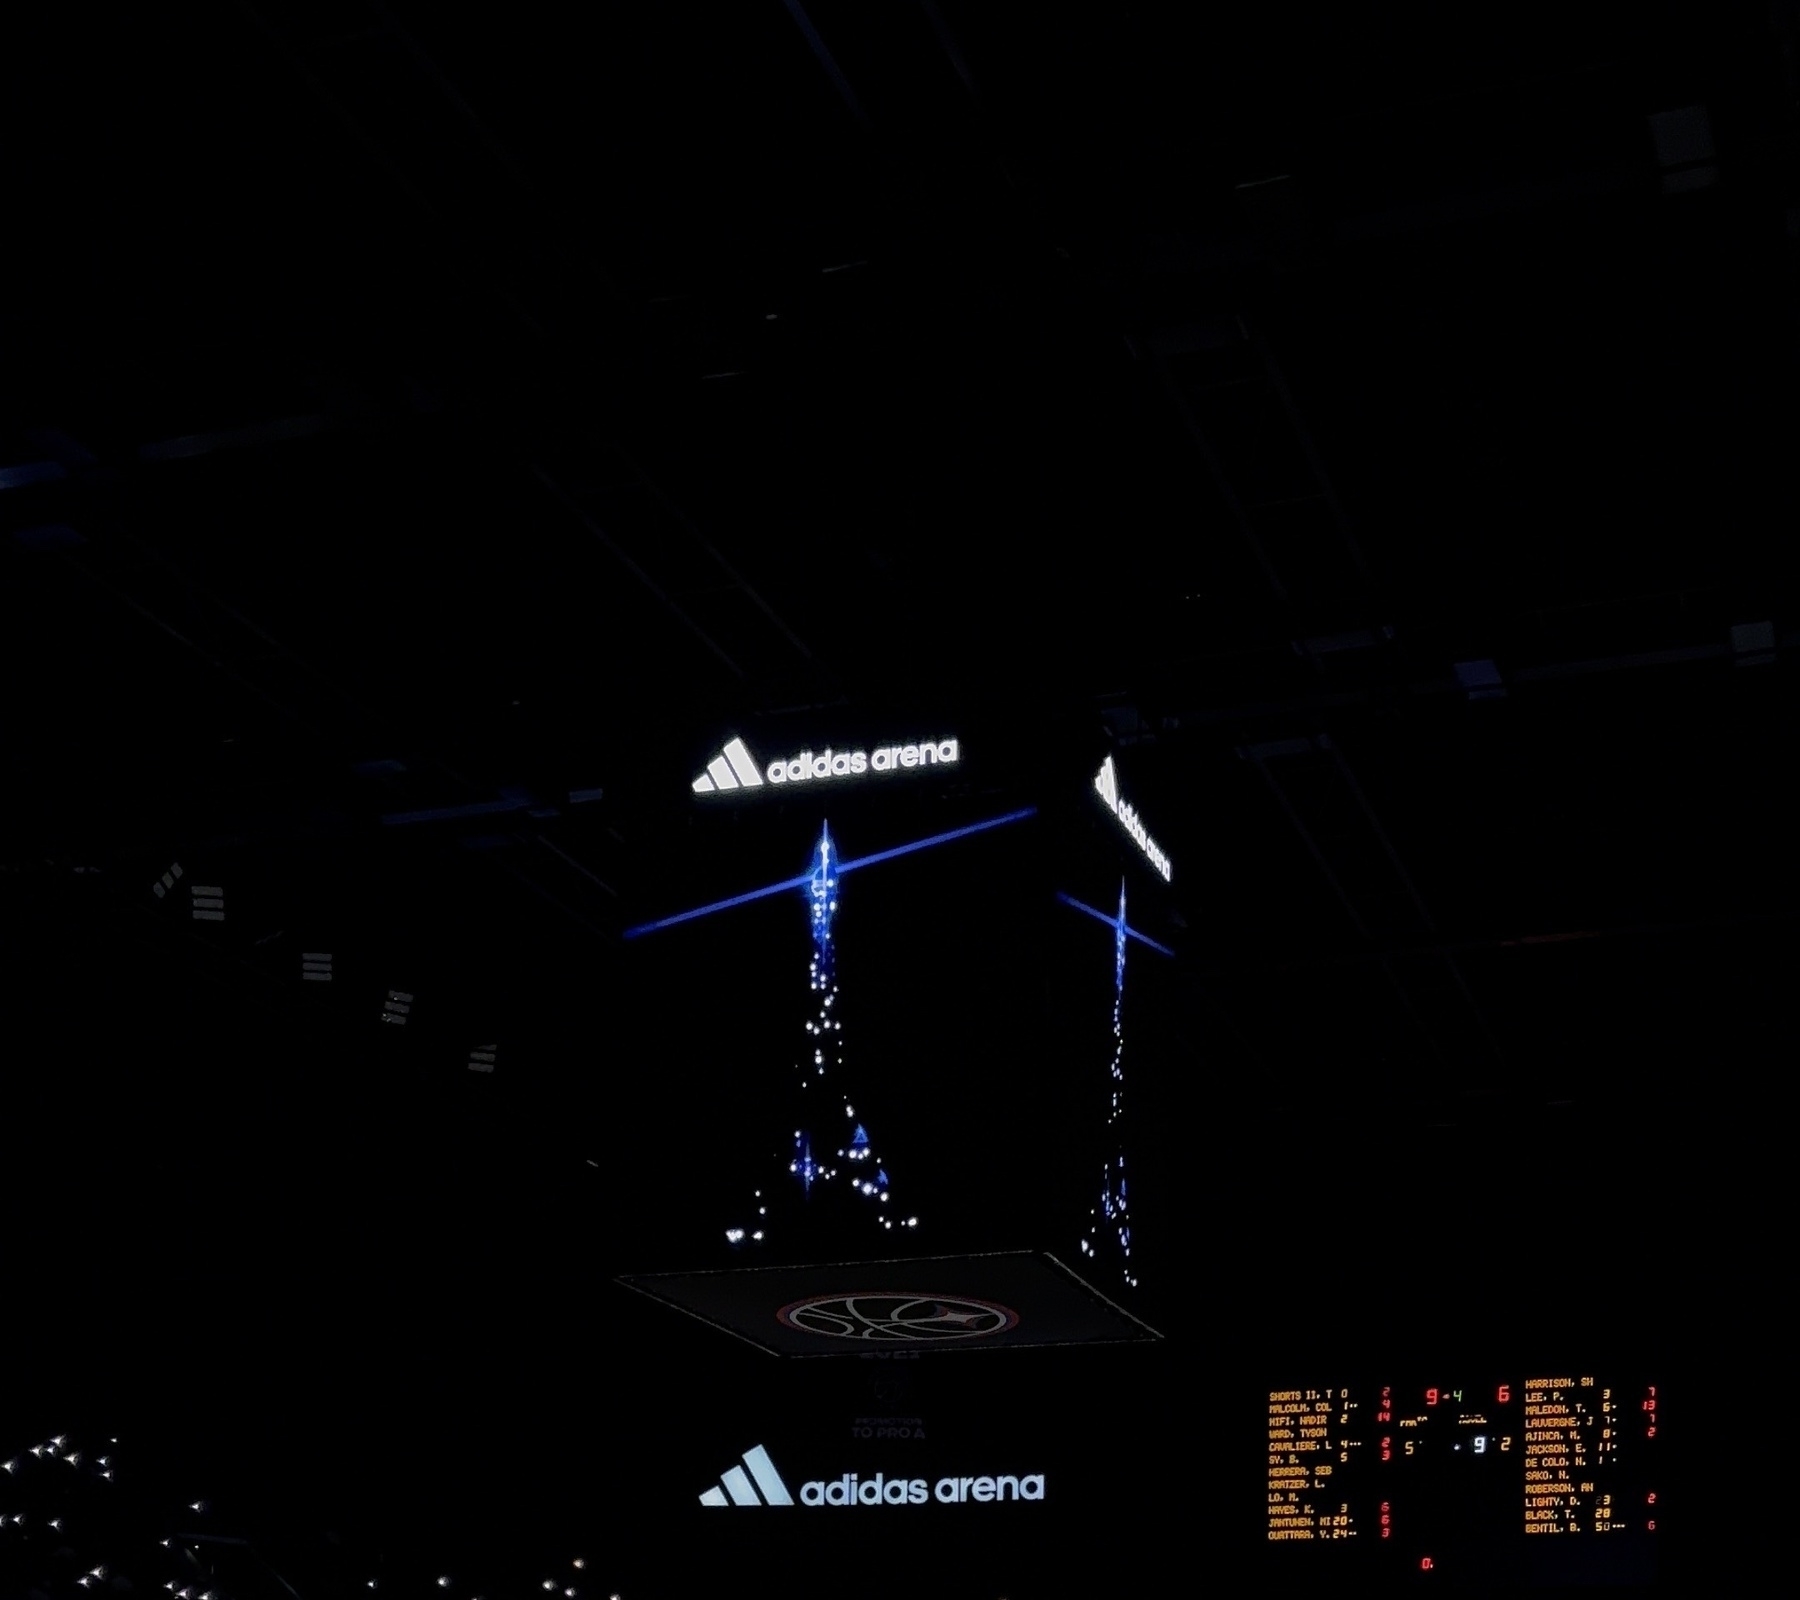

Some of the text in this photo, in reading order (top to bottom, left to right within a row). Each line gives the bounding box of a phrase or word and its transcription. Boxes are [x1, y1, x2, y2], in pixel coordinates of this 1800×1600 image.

[767, 738, 959, 784] adidas arena
[1525, 1378, 1575, 1389] HARRISON,
[1326, 1389, 1333, 1399] T
[1341, 1388, 1349, 1399] 0
[1426, 1385, 1510, 1405] 9 4 6
[1525, 1392, 1547, 1402] LEE,
[1603, 1388, 1611, 1399] 3
[1648, 1386, 1656, 1397] 7
[1315, 1402, 1333, 1413] COL
[1382, 1399, 1391, 1409] 4
[1340, 1413, 1348, 1424] 2
[1378, 1412, 1391, 1422] 14
[1586, 1416, 1594, 1426] J
[876, 1426, 912, 1439] PRO
[1647, 1427, 1657, 1437] 2
[1325, 1440, 1333, 1450] L
[1341, 1440, 1348, 1449] 4
[1381, 1437, 1391, 1448] 2
[1474, 1436, 1486, 1453] 9
[1500, 1437, 1511, 1451] 2
[1525, 1443, 1570, 1454] JACKSON,
[1381, 1450, 1391, 1461] 3
[1525, 1457, 1538, 1467] DE
[800, 1473, 1045, 1507] adidas arena
[1525, 1497, 1564, 1507] LIGHTY,
[1647, 1493, 1657, 1504] 2
[1341, 1503, 1348, 1513] 3
[1332, 1516, 1348, 1527] 20
[1594, 1521, 1611, 1532] 50
[1648, 1520, 1656, 1531] 6
[1332, 1528, 1348, 1539] 24
[1381, 1527, 1391, 1538] 3
